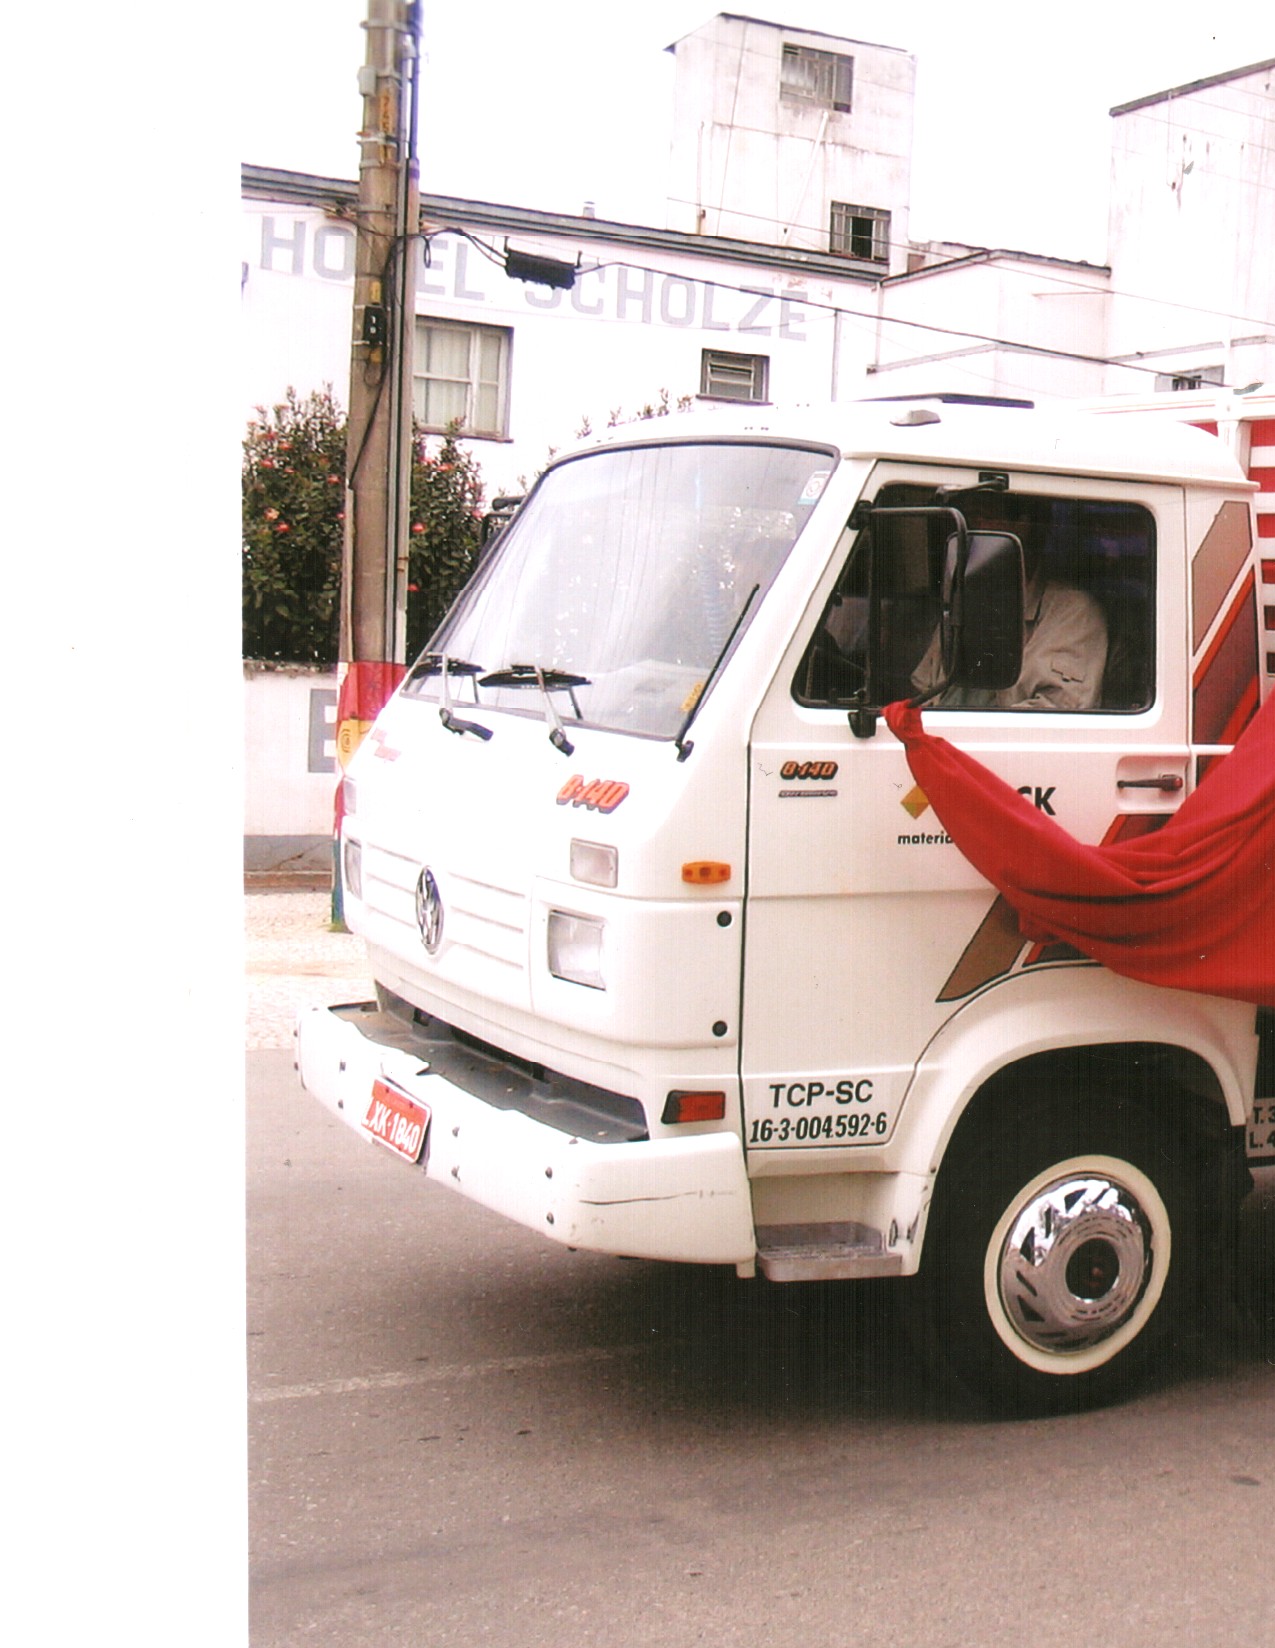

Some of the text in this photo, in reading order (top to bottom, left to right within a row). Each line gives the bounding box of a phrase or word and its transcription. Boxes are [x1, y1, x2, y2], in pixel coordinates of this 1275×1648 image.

[261, 215, 485, 301] HOEL
[769, 1079, 873, 1108] TCP-SC
[1249, 1131, 1263, 1149] L.
